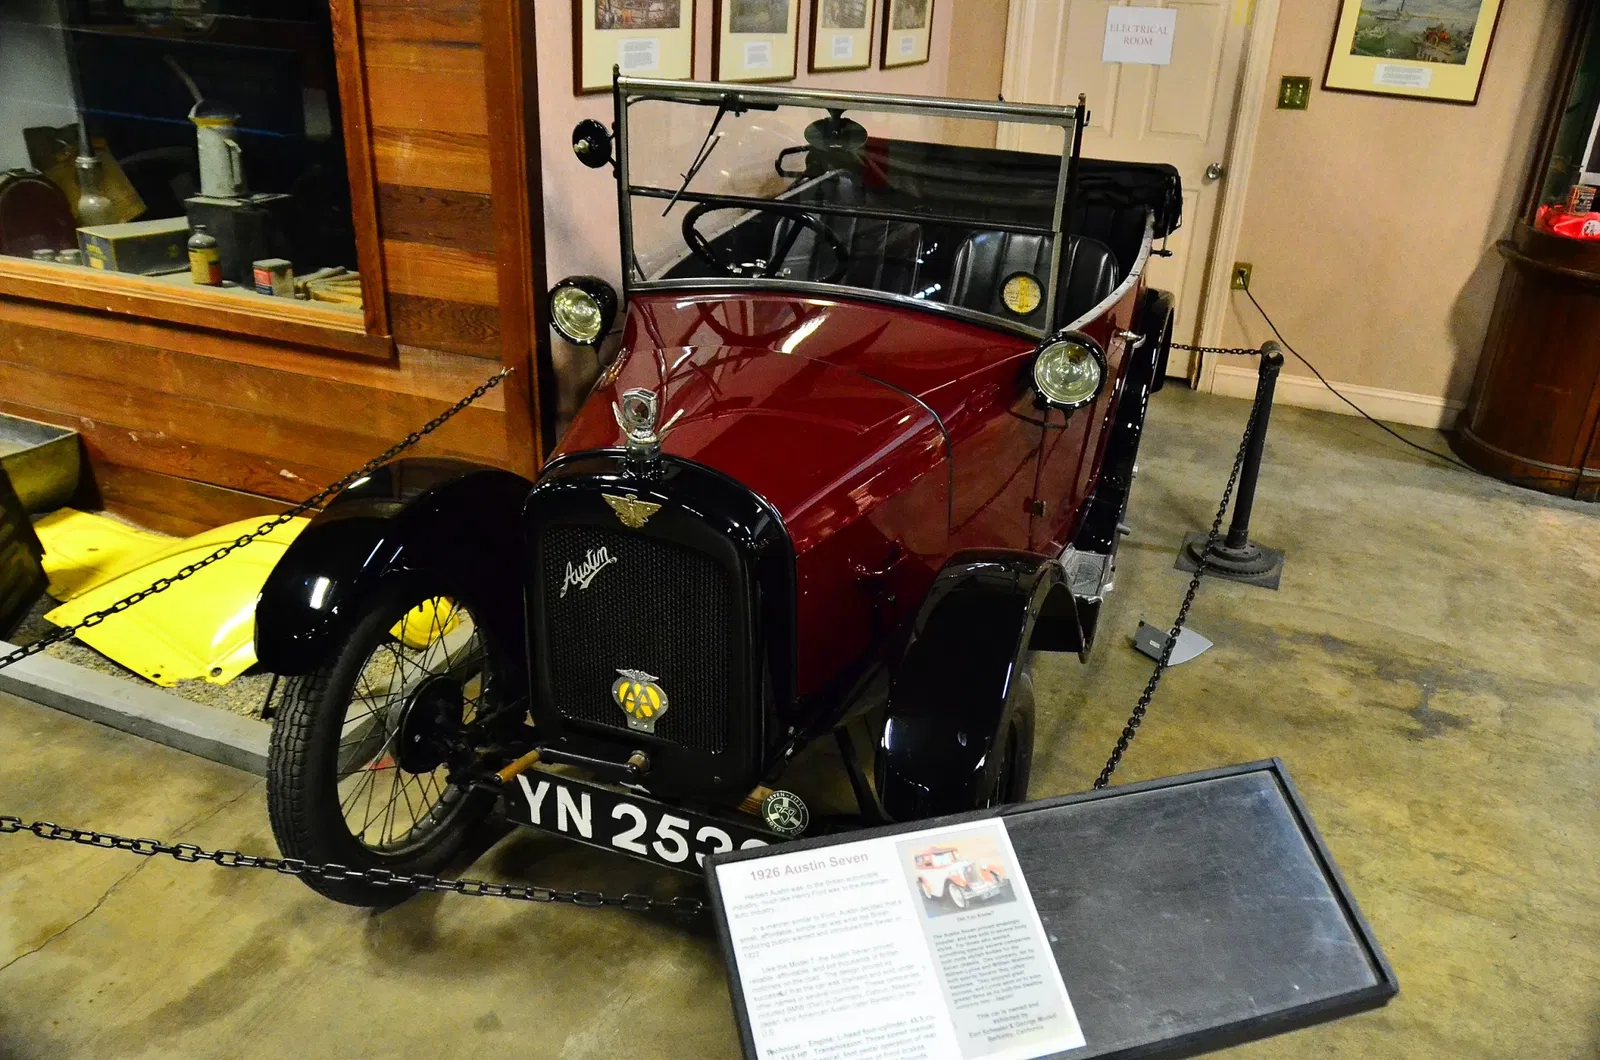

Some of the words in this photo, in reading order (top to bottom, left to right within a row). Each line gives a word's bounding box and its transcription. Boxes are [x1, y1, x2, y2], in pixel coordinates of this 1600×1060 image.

[1110, 23, 1169, 35] ELECTRICAL
[1123, 36, 1154, 46] ROOM
[559, 546, 618, 599] Austin
[517, 773, 593, 839] YN
[611, 803, 771, 868] 253
[750, 866, 781, 881] 1926
[784, 860, 826, 876] Austin
[829, 853, 869, 868] Seven
